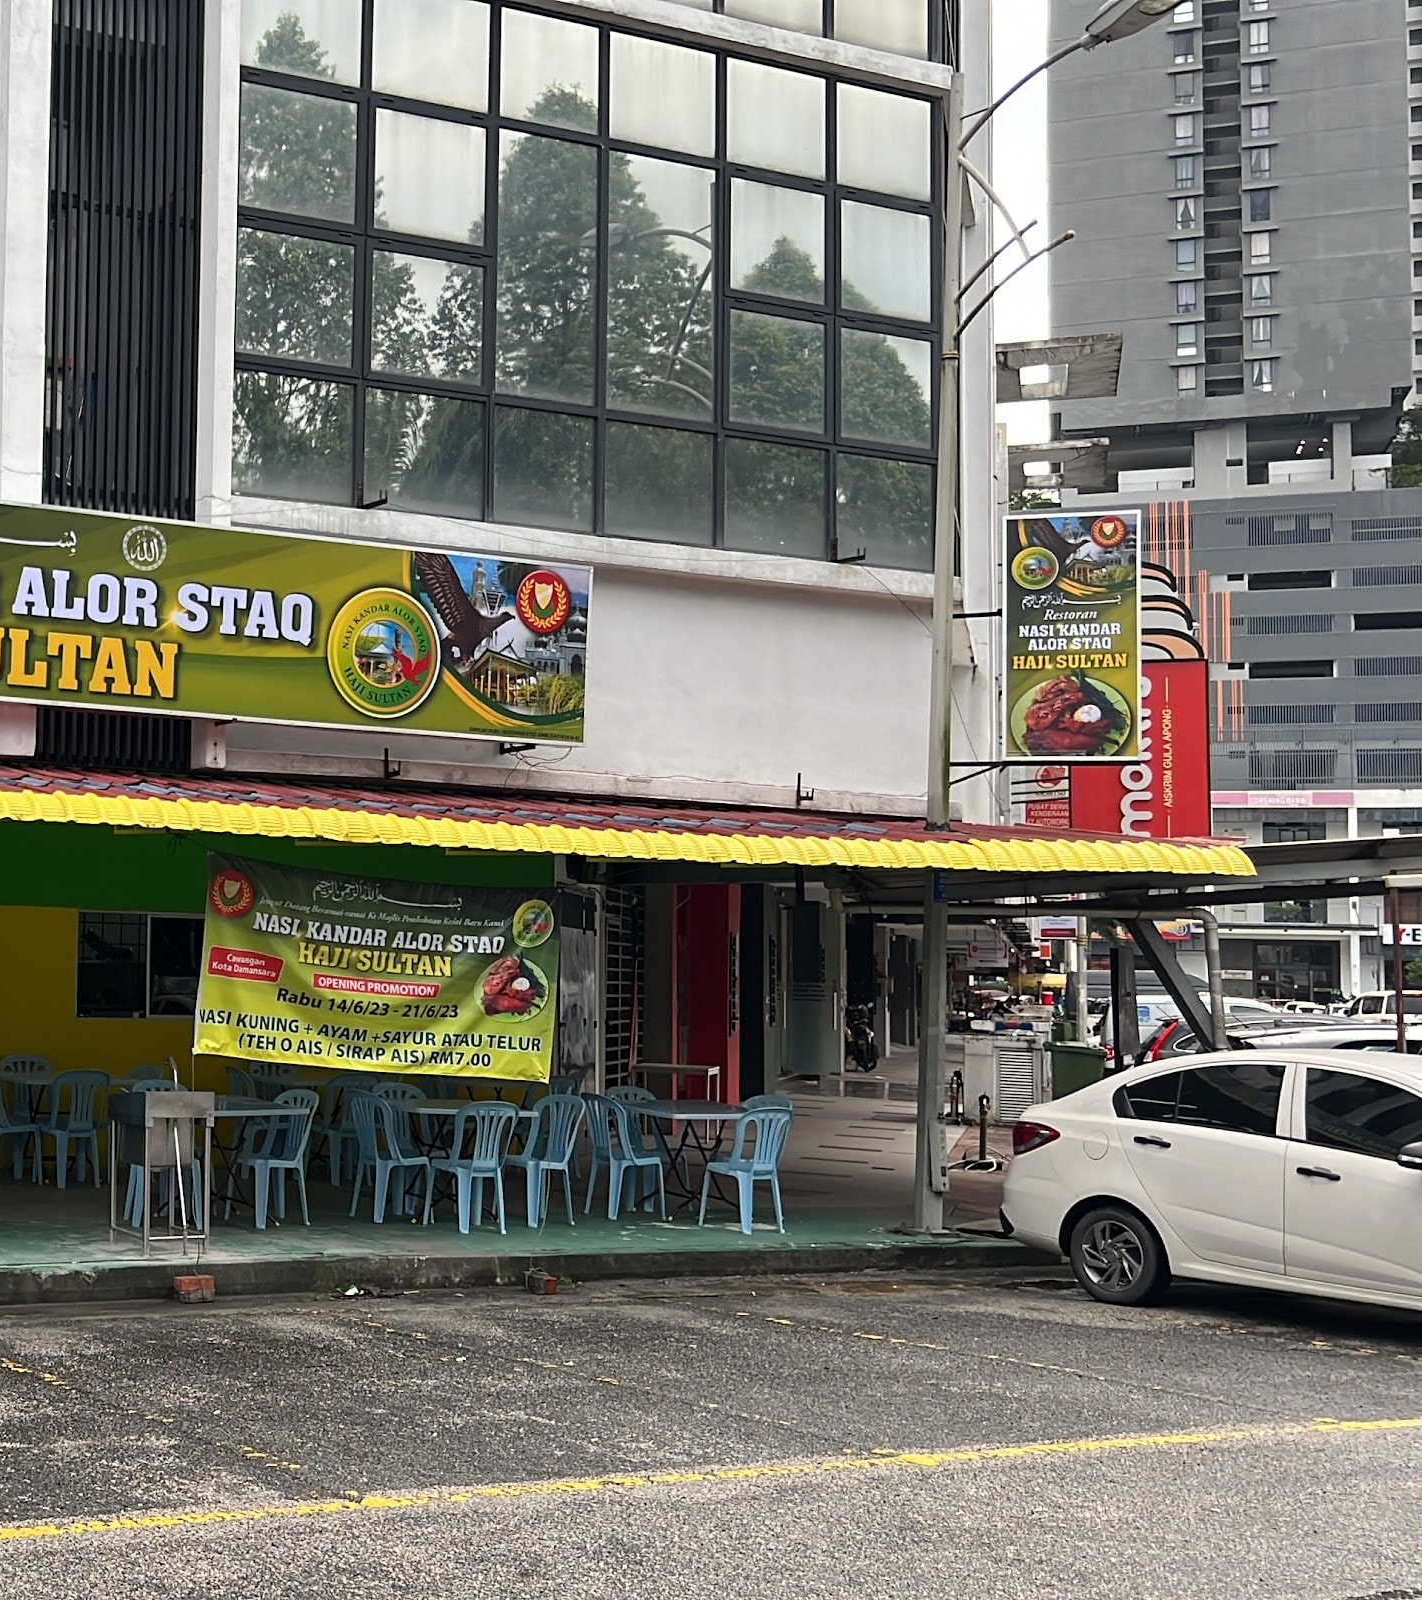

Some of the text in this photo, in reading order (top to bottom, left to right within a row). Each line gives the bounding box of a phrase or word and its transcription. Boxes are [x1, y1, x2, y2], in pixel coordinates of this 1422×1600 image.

[12, 566, 159, 628] ALOR
[177, 583, 314, 646] STAQ
[1043, 609, 1098, 620] Restoran
[342, 625, 356, 650] NASI
[353, 604, 390, 625] KANDAR
[393, 607, 416, 626] ALOR
[1019, 623, 1121, 637] NASI KANDAR
[1028, 639, 1067, 651] ALOR
[1013, 653, 1127, 669] HAJI SULTAN
[344, 667, 412, 704] HAJI SULTAN
[1162, 708, 1172, 742] APONG
[1162, 743, 1173, 769] GULA
[252, 912, 300, 936] NASI
[305, 920, 388, 947] KANDAR
[391, 931, 444, 952] ALOR
[212, 961, 276, 977] Kota Damansara
[226, 954, 265, 966] Cawangan
[298, 942, 453, 977] HAJI SULTAN
[318, 977, 436, 997] OPENING PROMOTION
[277, 988, 323, 1009] Rabu
[328, 998, 389, 1016] 14/6/23
[401, 1004, 458, 1018] 21/6/23
[236, 1013, 299, 1034] KUNING
[317, 1024, 368, 1042] AYAM
[441, 1032, 483, 1048] ATAU
[487, 1035, 541, 1051] TELUR
[239, 1033, 276, 1050] (TEH
[280, 1038, 292, 1052] O
[296, 1039, 323, 1055] AIS
[336, 1043, 386, 1061] SIRAP
[390, 1049, 425, 1066] AIS)
[429, 1051, 492, 1067] RM7.00
